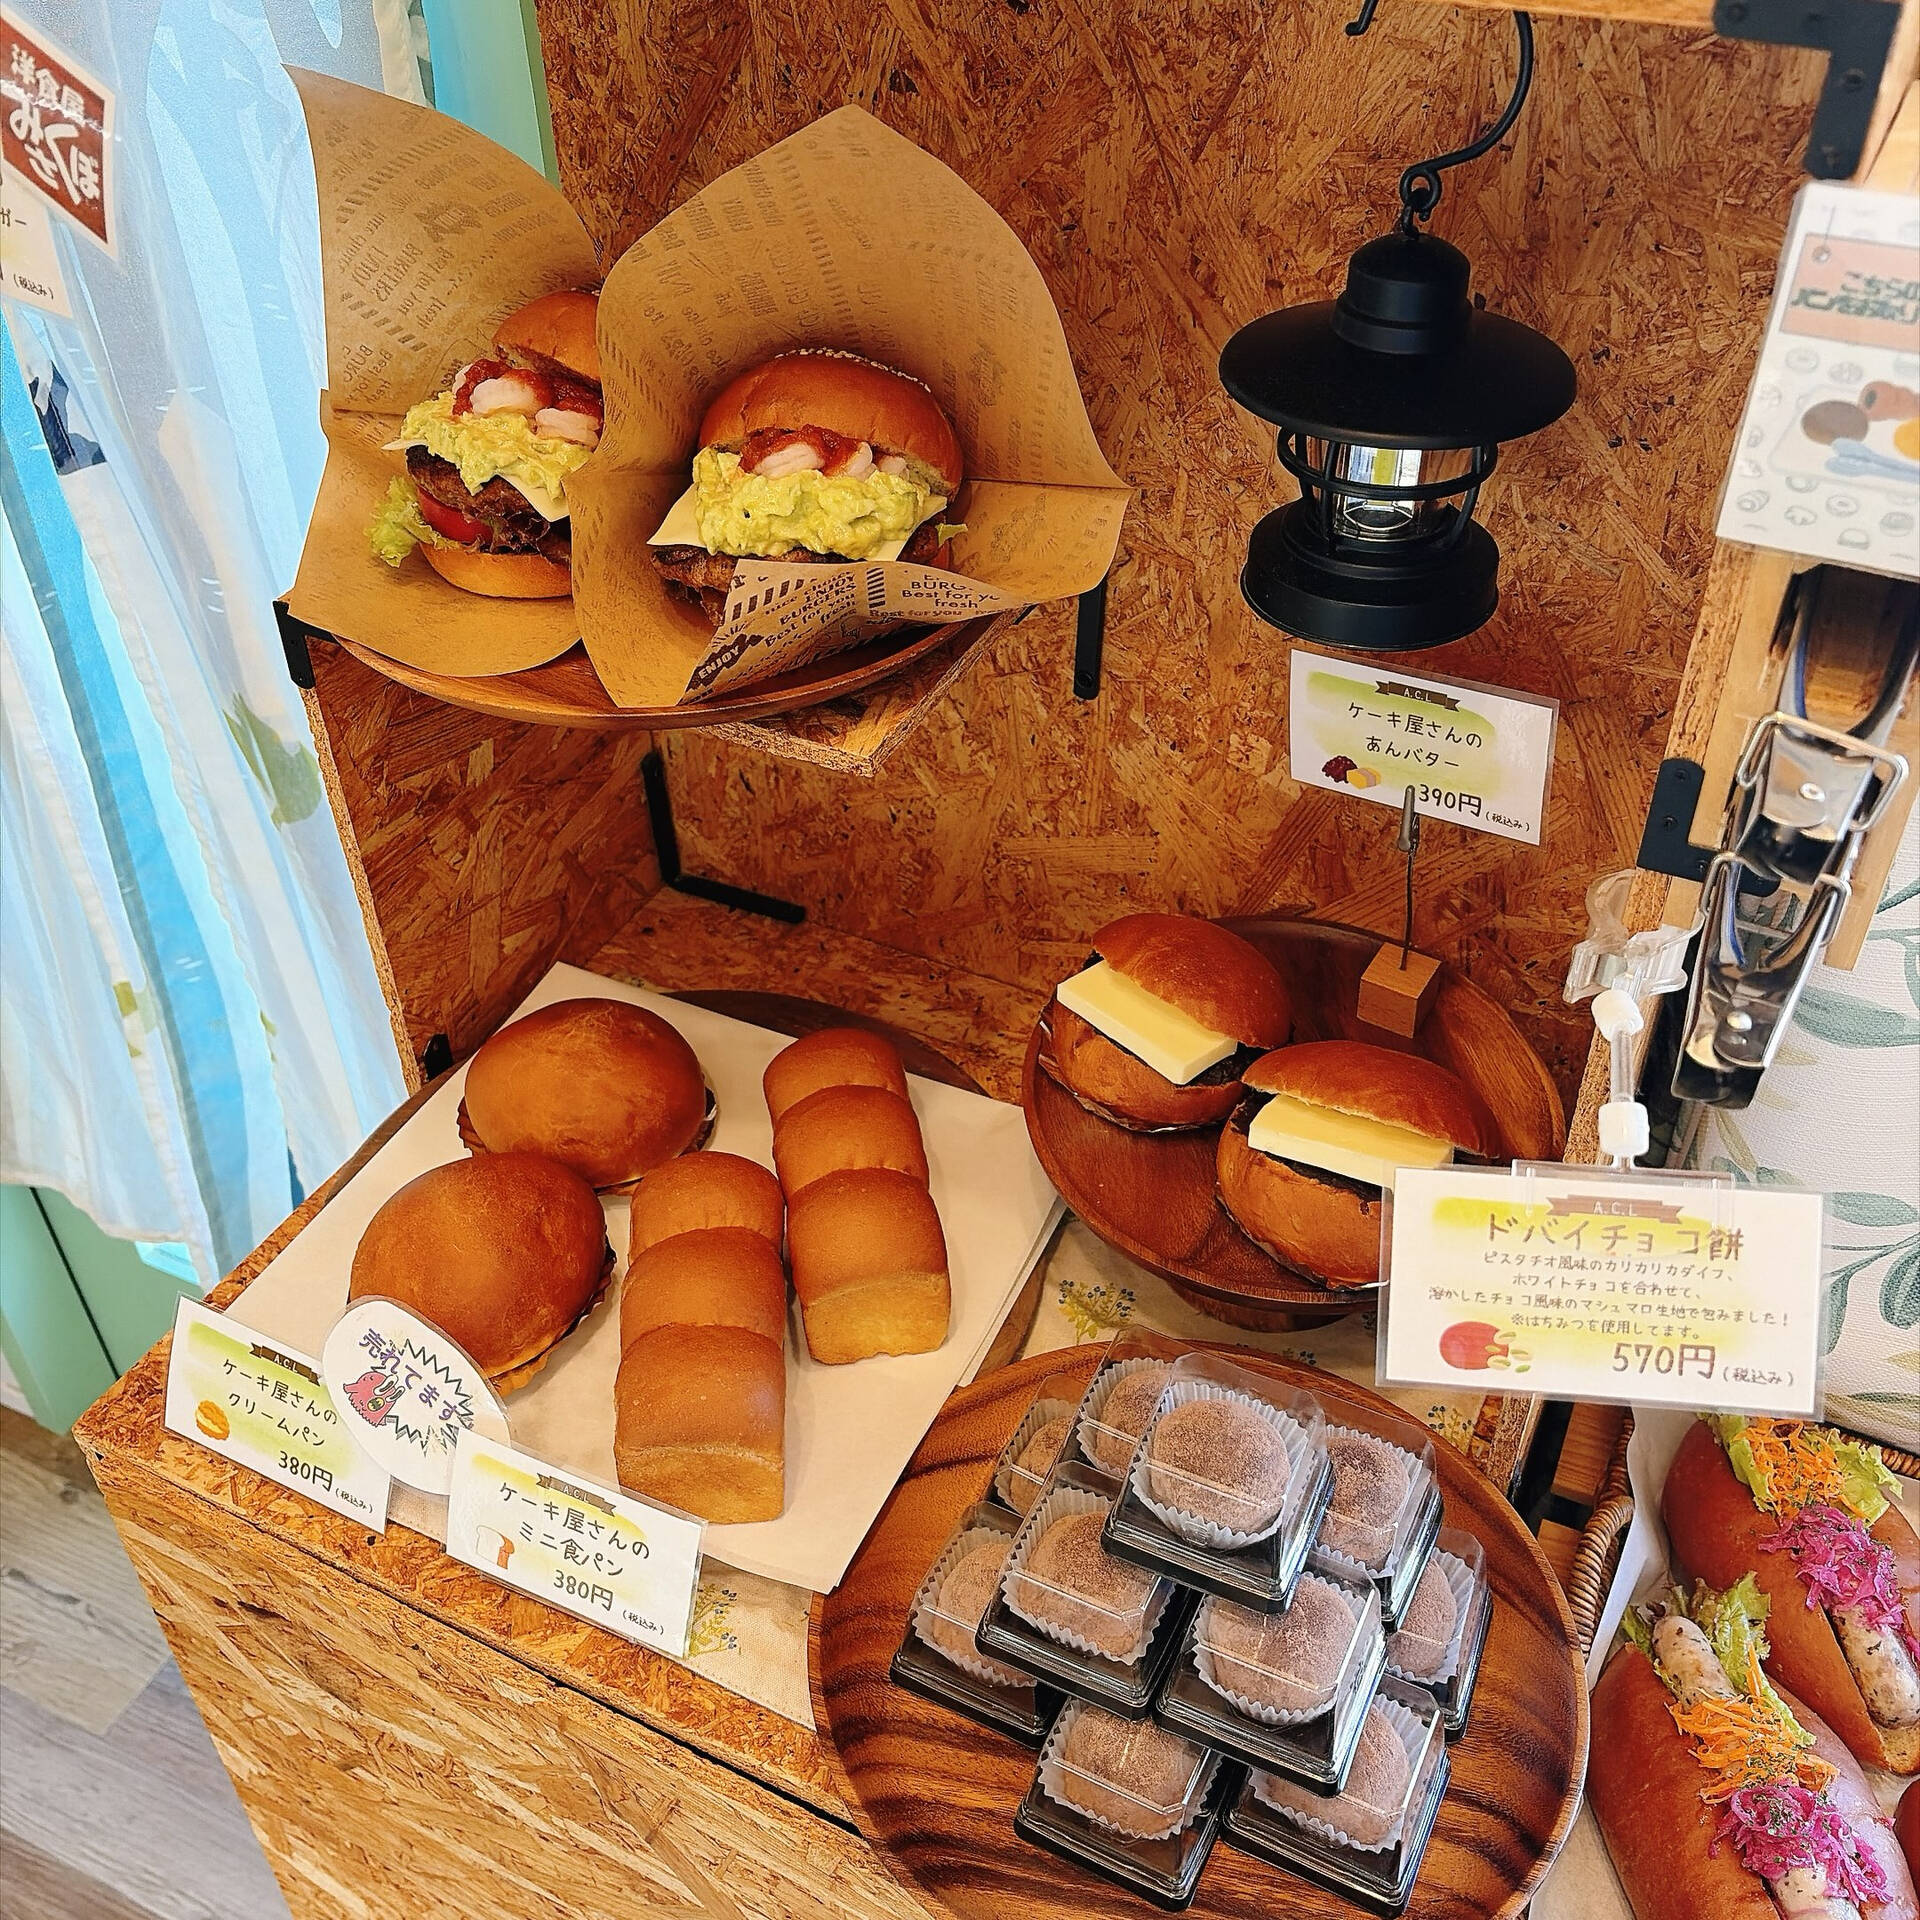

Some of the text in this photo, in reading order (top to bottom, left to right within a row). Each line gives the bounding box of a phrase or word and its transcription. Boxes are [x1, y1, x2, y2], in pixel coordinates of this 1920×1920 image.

[935, 598, 978, 609] fresh
[698, 644, 742, 680] ENJOY
[1348, 702, 1483, 748] ケーキ屋さんの
[1365, 735, 1459, 768] あんバター
[1418, 784, 1482, 817] 390円
[1488, 1214, 1744, 1261] ドバイチョコ餅
[1512, 1273, 1702, 1299] ホワイトチョコを合わせて、
[1613, 1343, 1715, 1380] 570円
[222, 1359, 338, 1425] ケーキ屋さんの
[228, 1393, 326, 1447] クリームパン
[278, 1450, 334, 1491] 380円
[500, 1482, 650, 1559] ケーキ屋さんの
[520, 1521, 624, 1576] ミニ食パン
[553, 1570, 614, 1611] 380円
